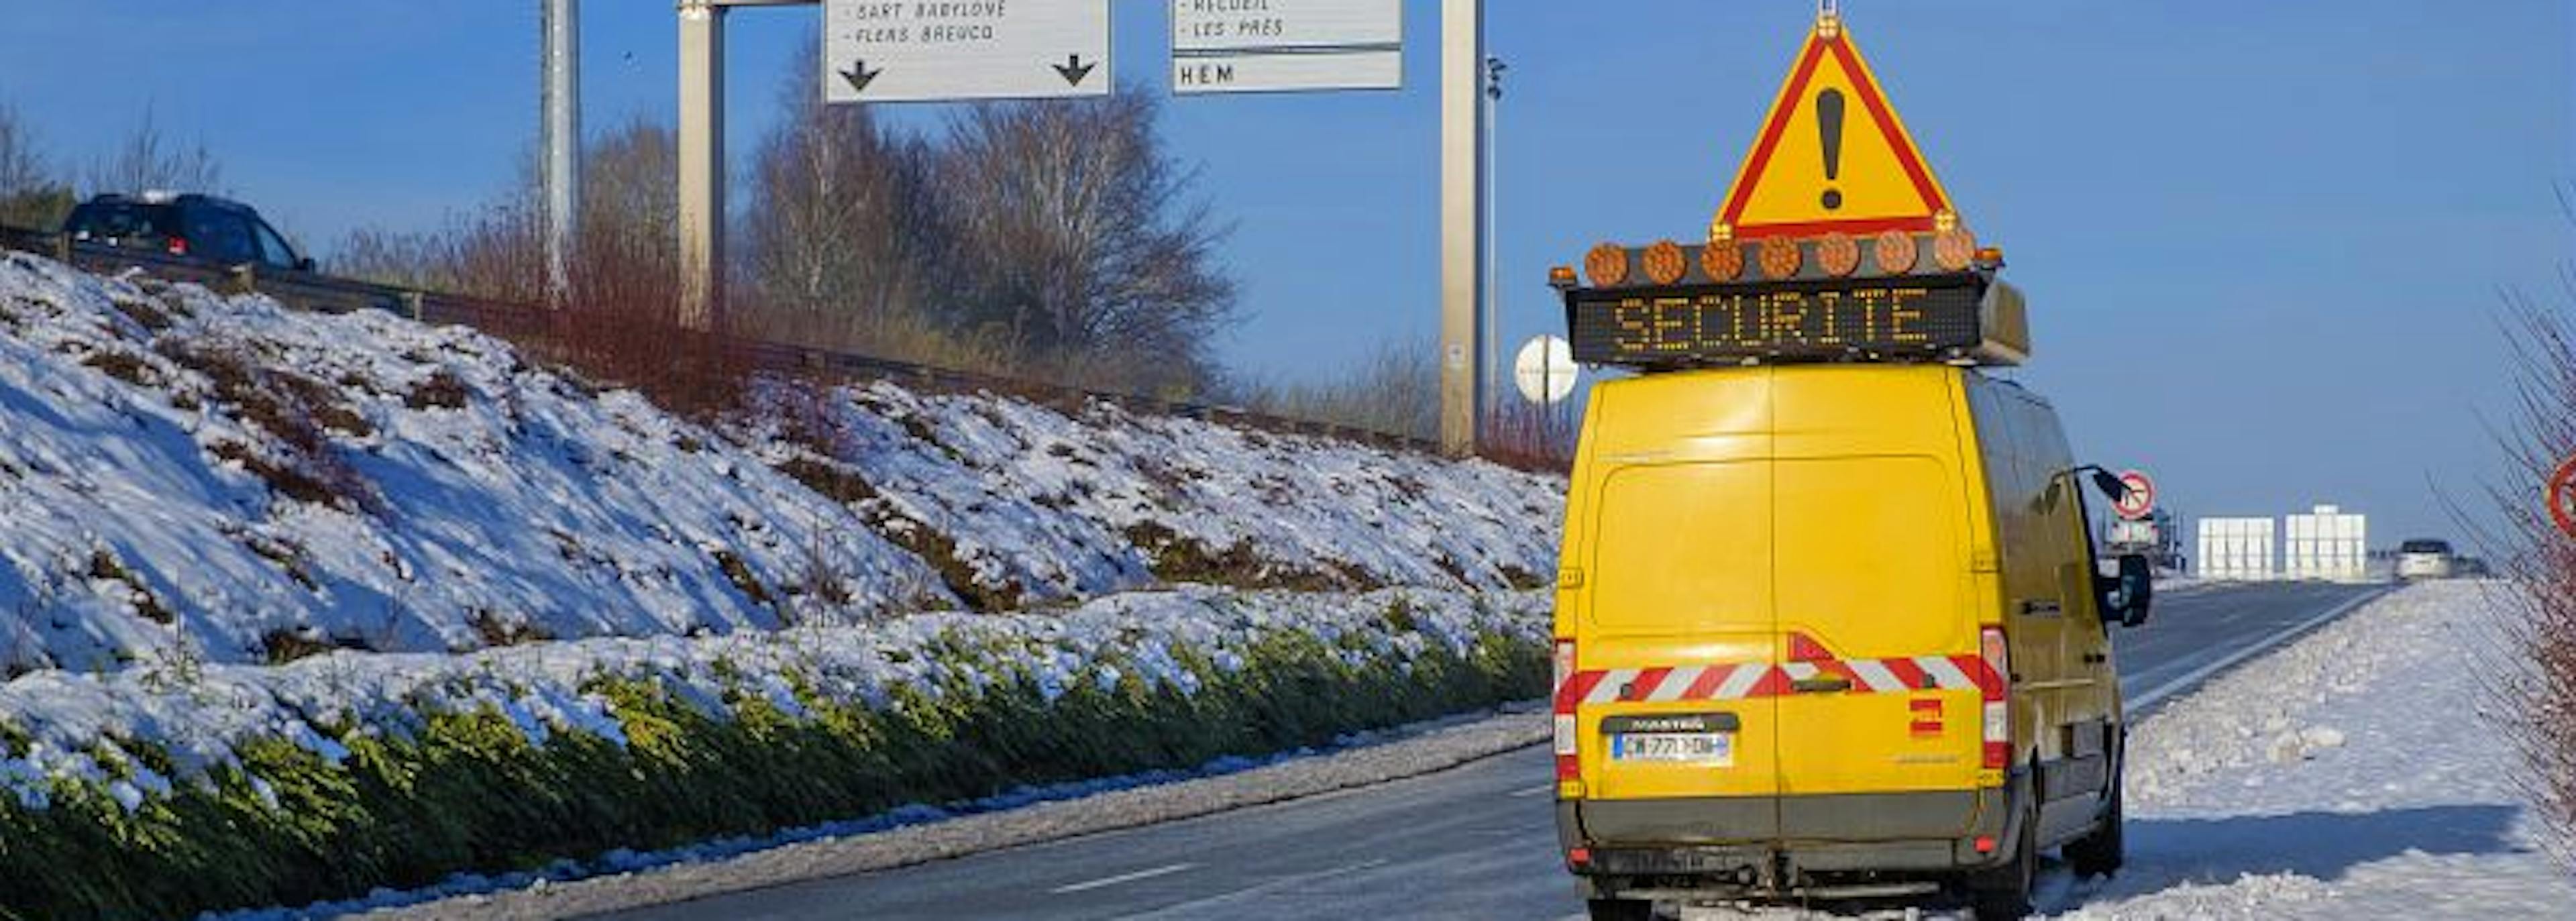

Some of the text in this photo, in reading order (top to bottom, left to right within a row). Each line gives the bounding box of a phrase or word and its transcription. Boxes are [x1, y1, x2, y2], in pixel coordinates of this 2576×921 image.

[1194, 22, 1225, 36] LES
[1181, 64, 1234, 85] HEM
[1615, 288, 1927, 350] SECURITE
